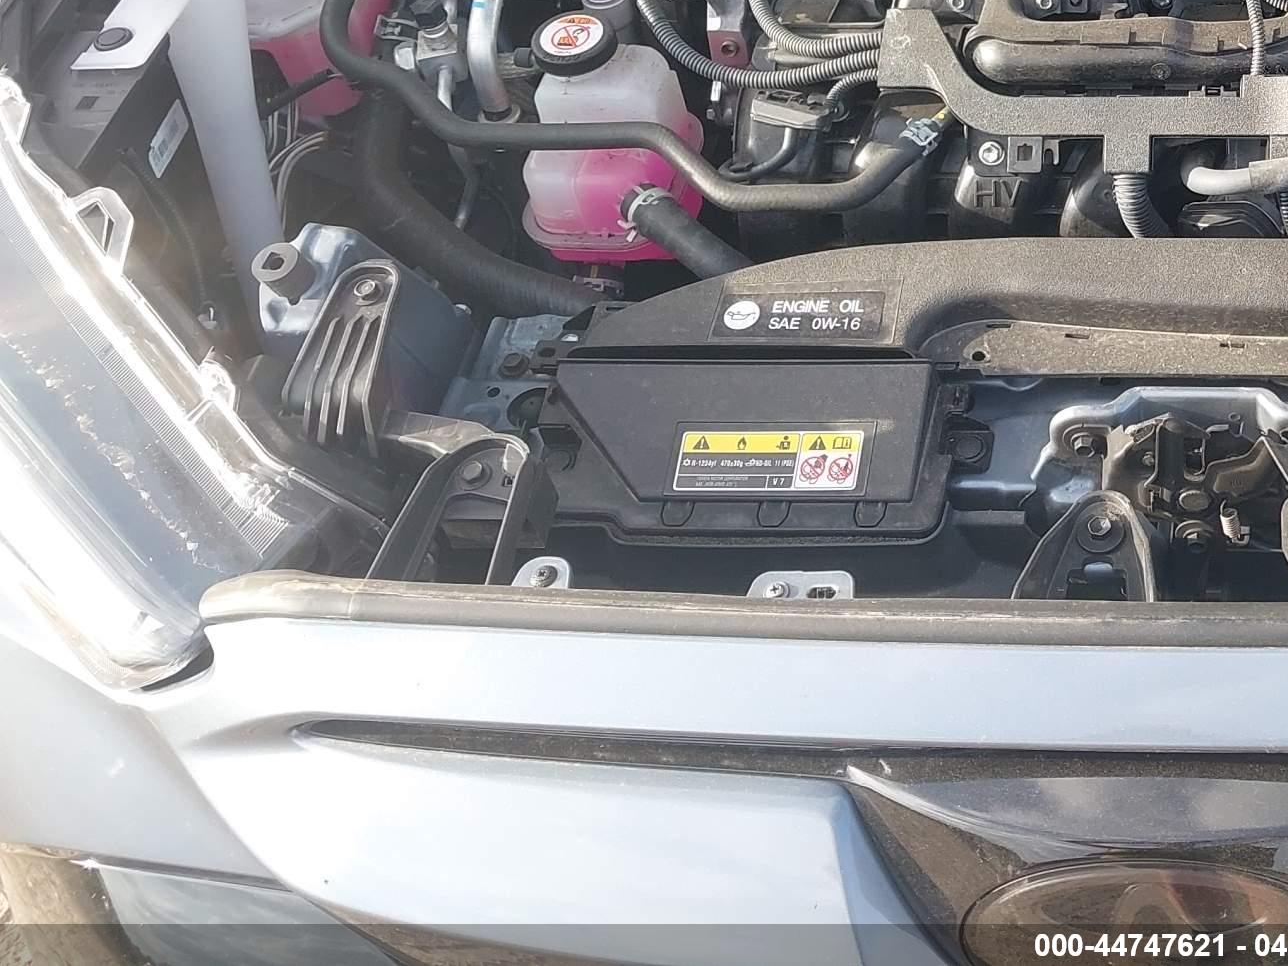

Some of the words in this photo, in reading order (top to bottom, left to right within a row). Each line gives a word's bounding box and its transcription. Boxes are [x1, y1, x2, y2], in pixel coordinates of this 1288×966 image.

[771, 299, 830, 313] ENGINE
[839, 299, 864, 313] OIL
[768, 317, 801, 330] SAE
[811, 317, 861, 330] 0W-16
